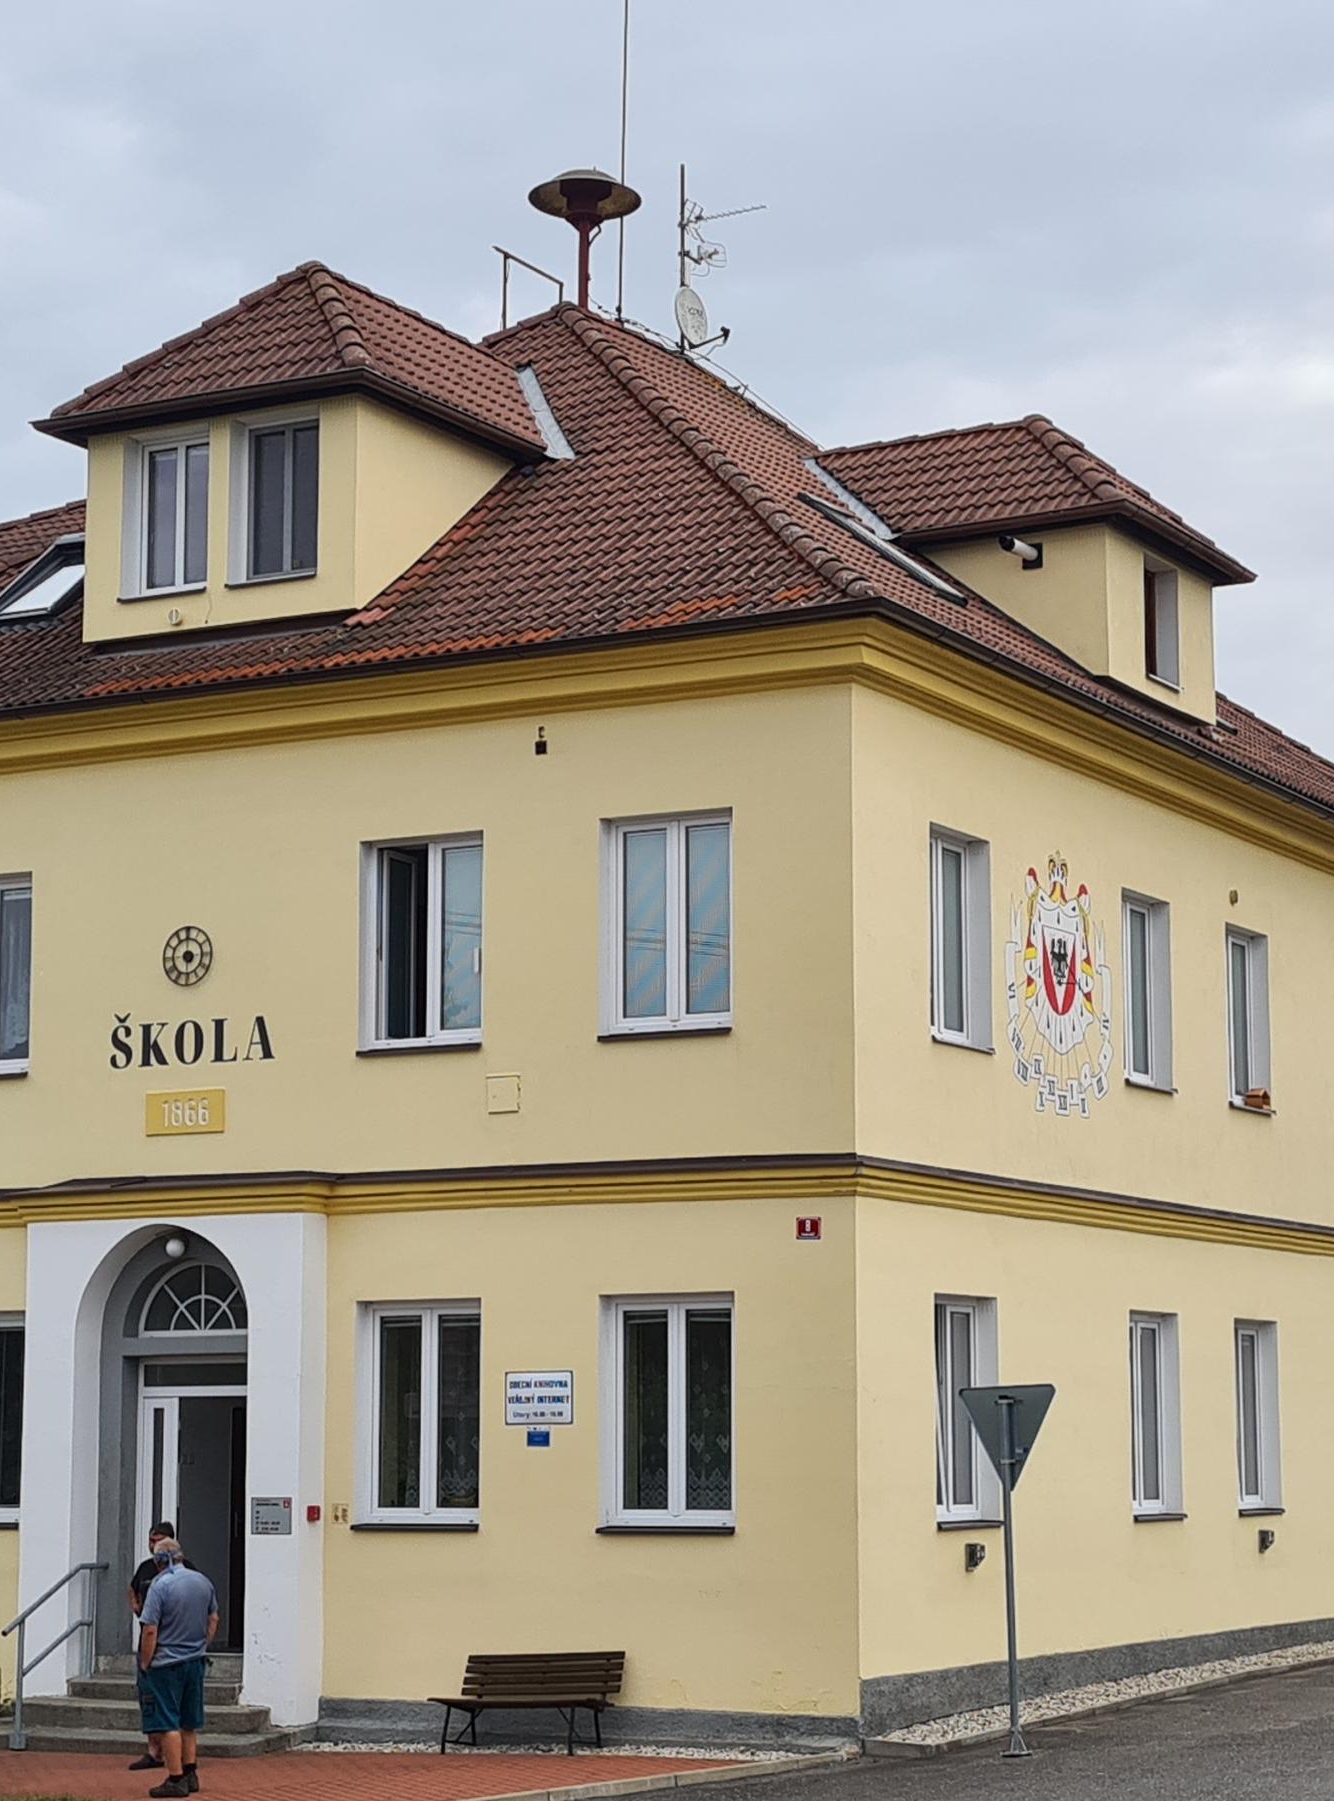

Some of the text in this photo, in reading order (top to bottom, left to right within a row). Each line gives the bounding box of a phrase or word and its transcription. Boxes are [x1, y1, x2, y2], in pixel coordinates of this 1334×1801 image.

[110, 1013, 275, 1069] ŠKOLA
[162, 1098, 209, 1128] 1866
[537, 1395, 569, 1404] INTERNET
